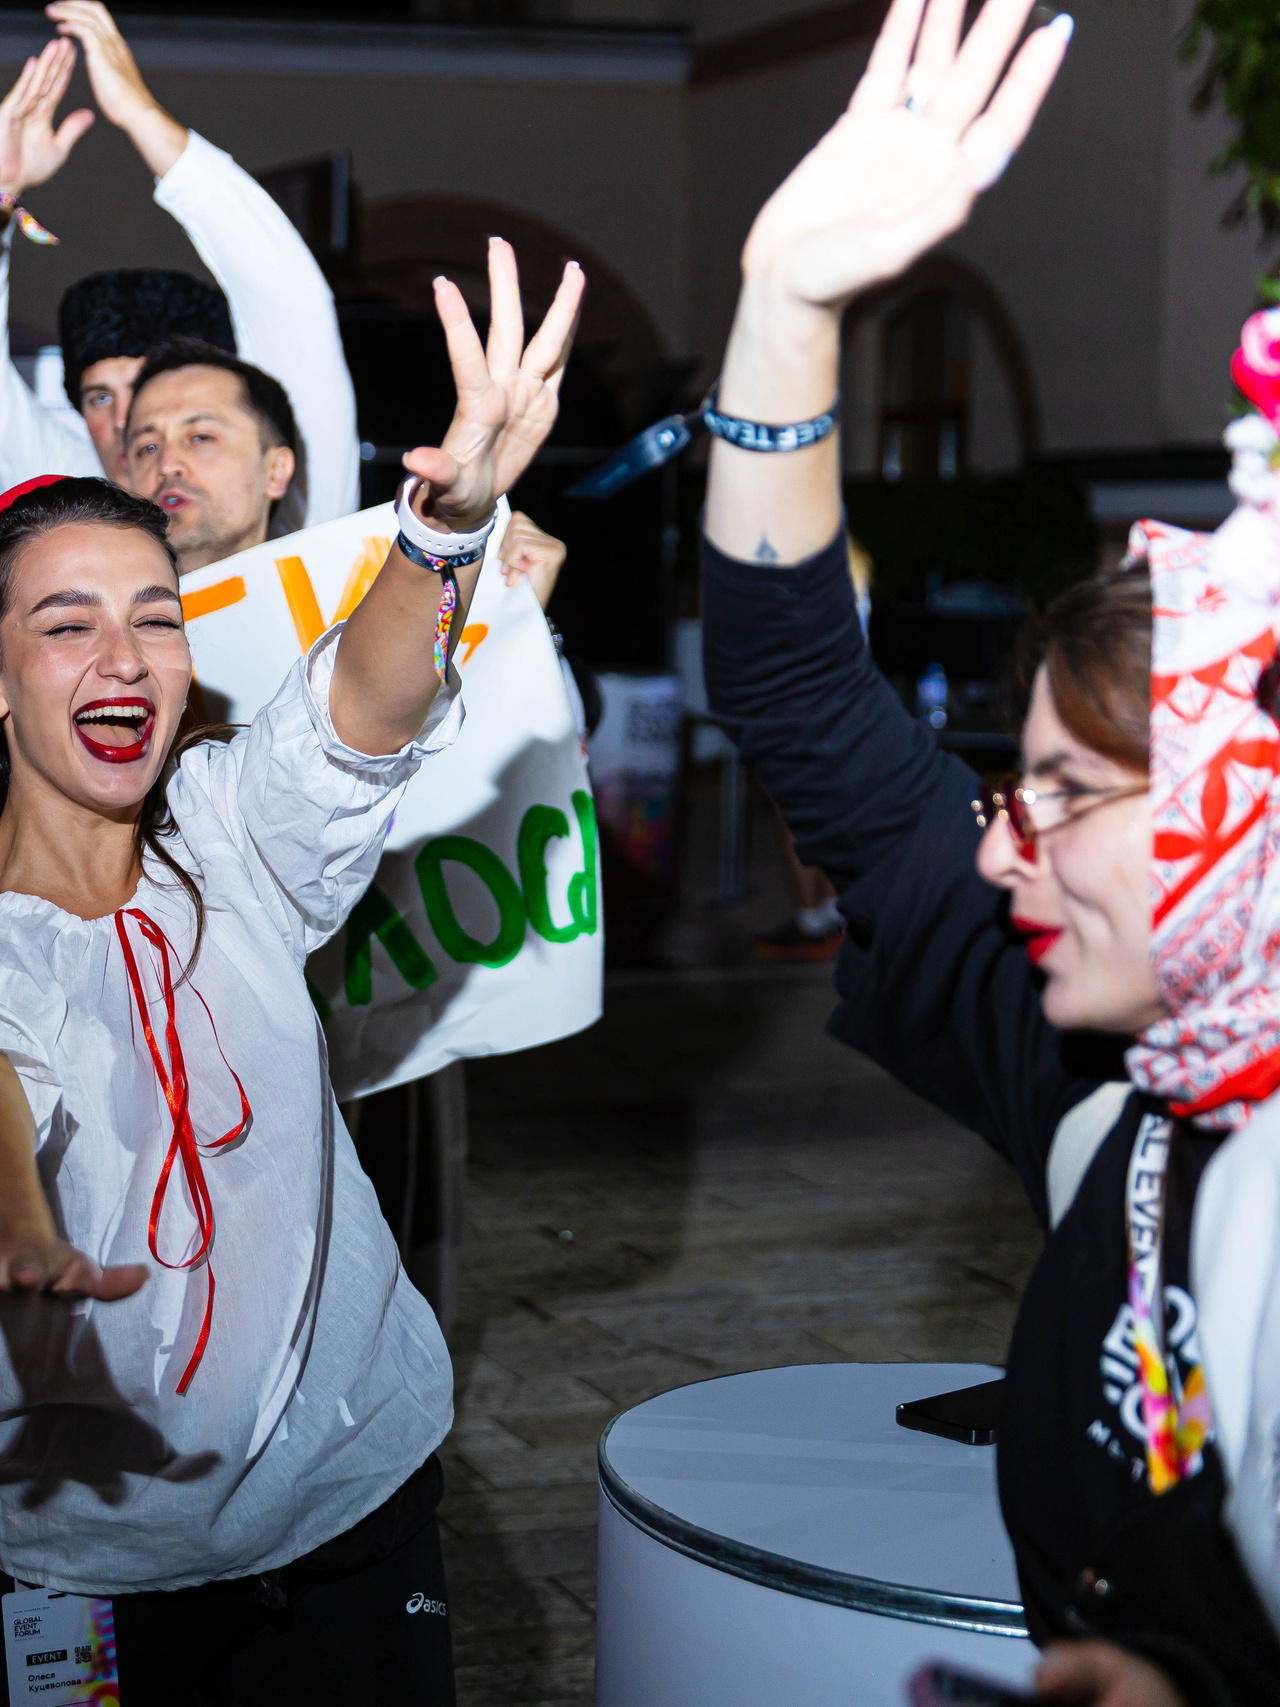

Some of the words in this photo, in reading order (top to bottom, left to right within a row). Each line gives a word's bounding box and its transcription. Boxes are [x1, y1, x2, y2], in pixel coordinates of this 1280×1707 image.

[13, 1616, 43, 1626] GLOBAL
[14, 1623, 38, 1632] EVENT
[14, 1629, 41, 1638] FORUM
[31, 1651, 62, 1664] EVENT
[28, 1672, 56, 1682] Олеся
